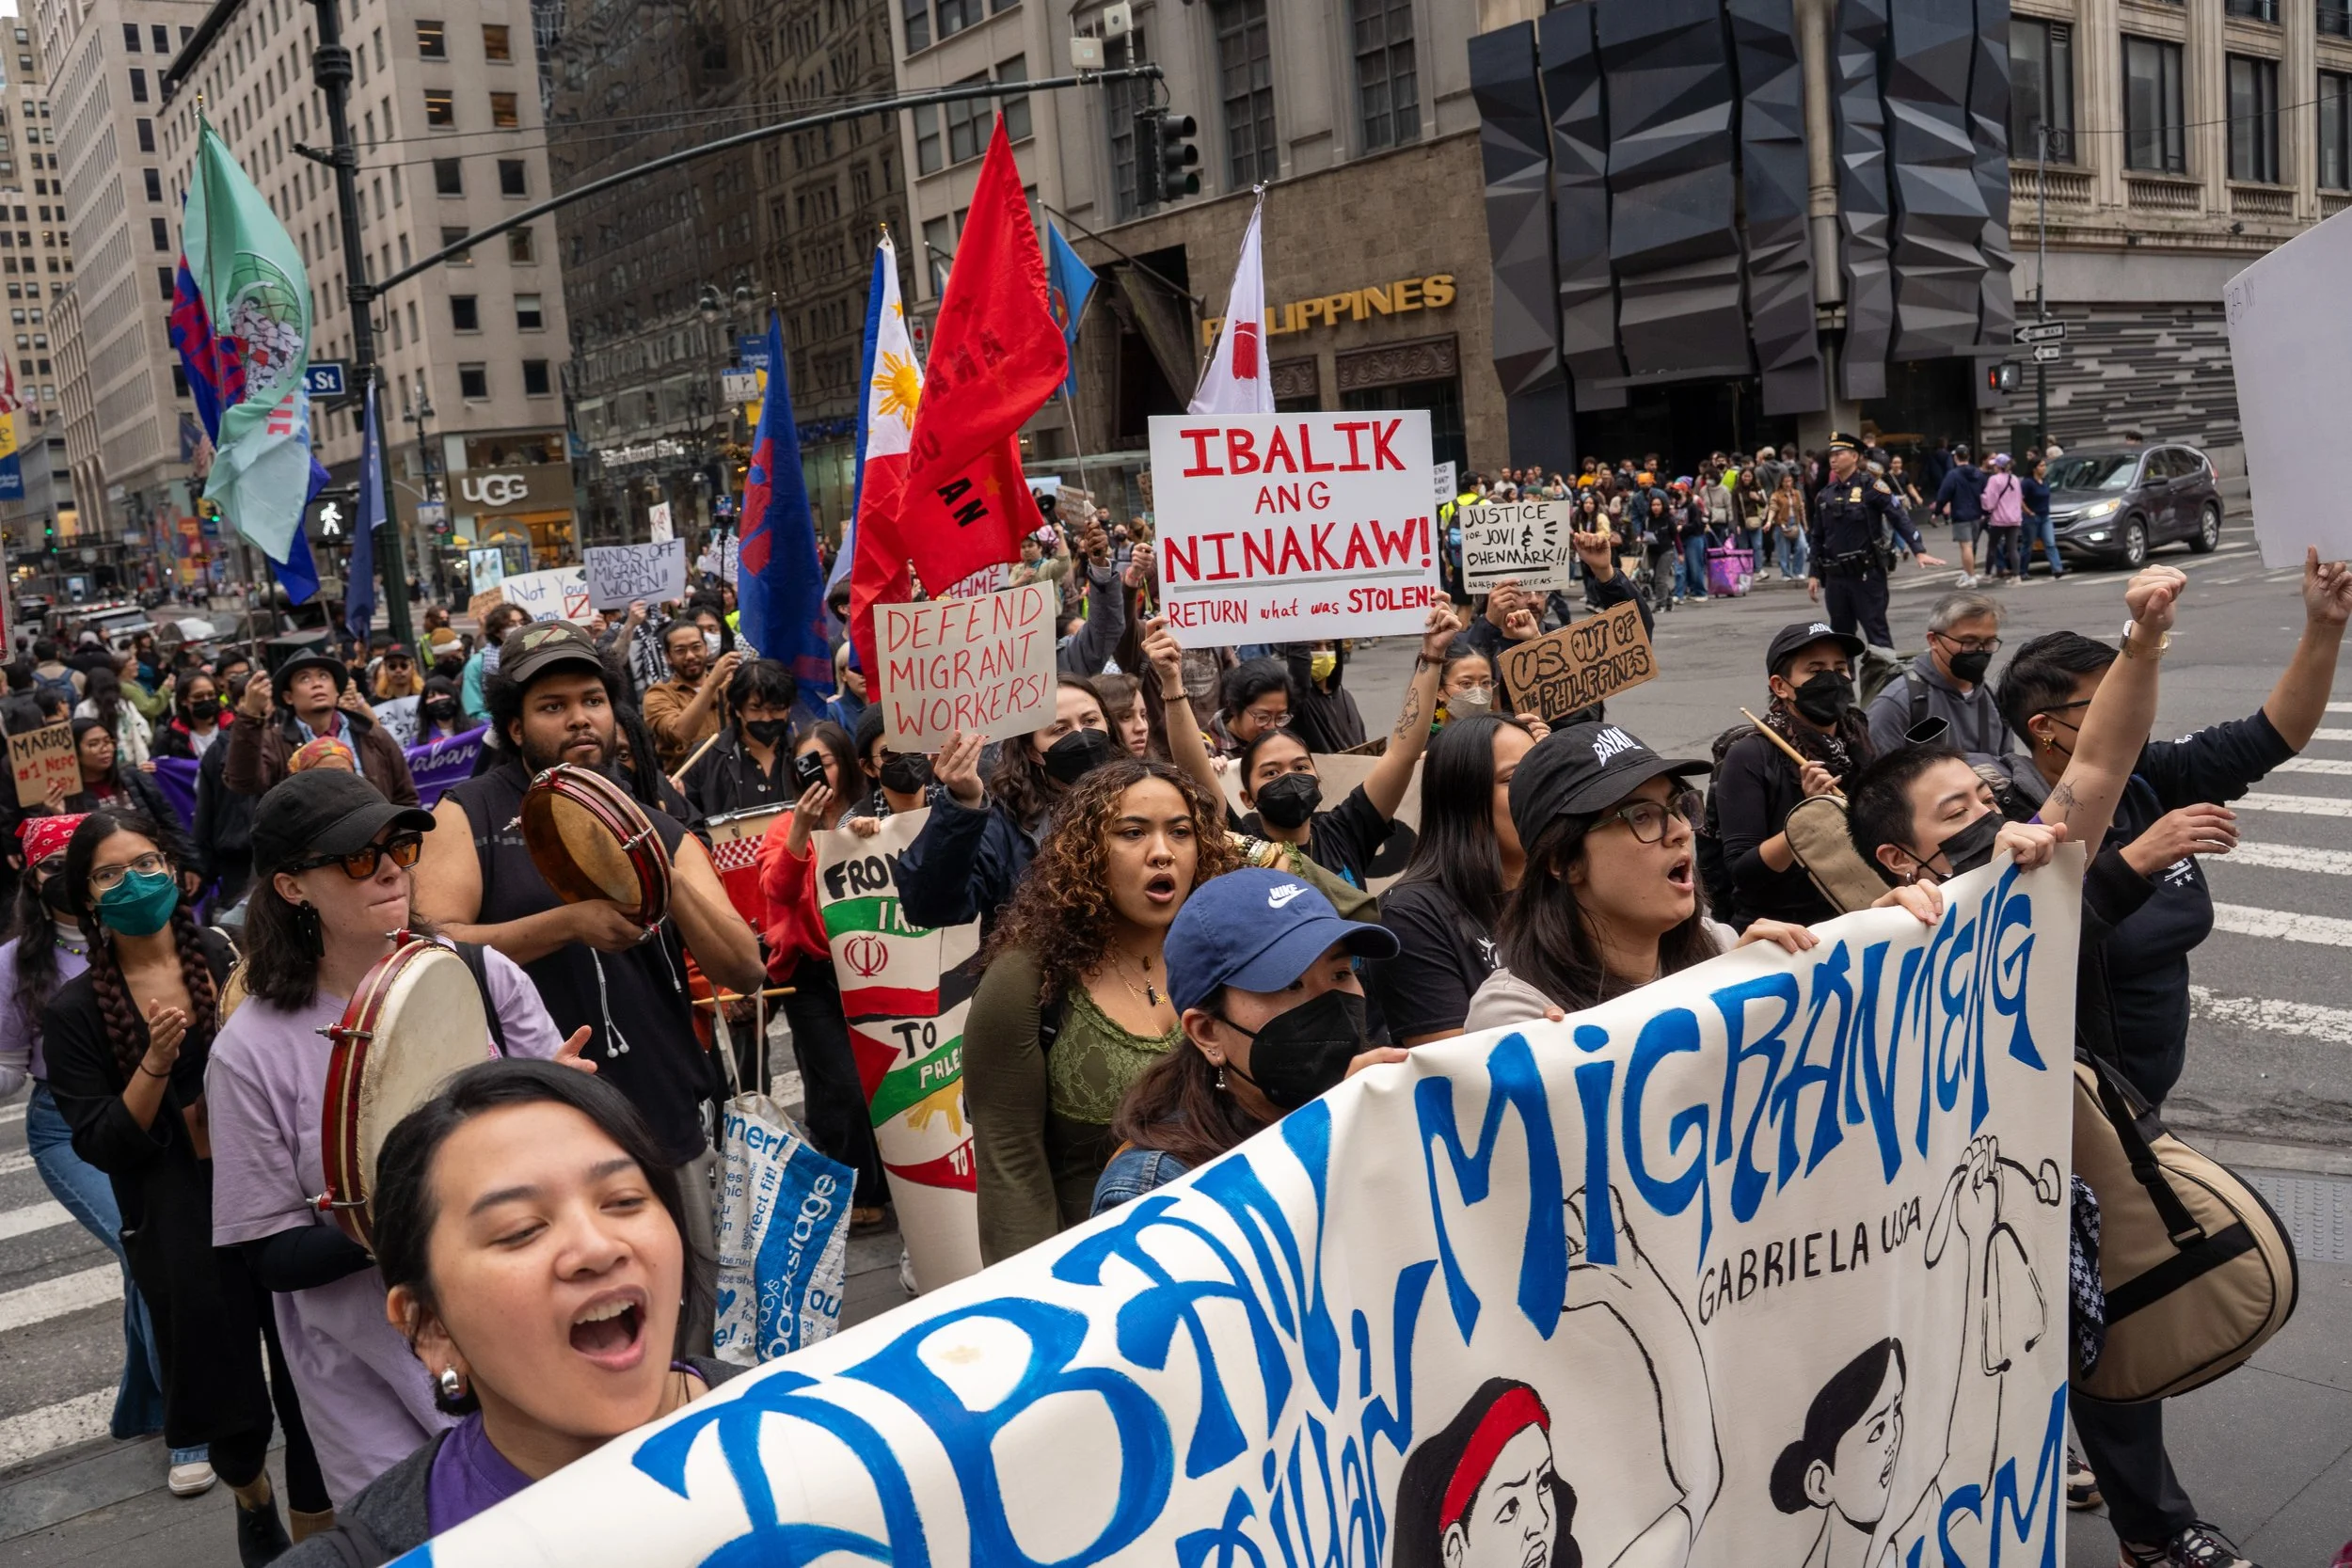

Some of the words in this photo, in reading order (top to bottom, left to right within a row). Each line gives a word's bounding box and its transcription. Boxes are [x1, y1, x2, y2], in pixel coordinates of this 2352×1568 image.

[1202, 274, 1456, 346] PLIPPINES
[314, 372, 335, 390] St
[1180, 419, 1406, 477] IBALIK
[461, 474, 528, 506] UGG
[1255, 482, 1330, 514] ANG
[1465, 504, 1549, 528] JUSTICE
[590, 546, 642, 566] HANDS
[649, 541, 676, 559] OFF
[1165, 516, 1431, 582] NINAKAW!
[1466, 531, 1482, 540] FOR
[1483, 528, 1515, 546] JOVI
[595, 558, 660, 581] MIGRANT
[509, 578, 546, 603] Not
[554, 575, 588, 596] Your
[1168, 600, 1248, 628] RETURN
[1261, 598, 1298, 619] what
[1311, 601, 1339, 615] was
[1347, 586, 1436, 613] STOLEN!
[887, 588, 1042, 652] DEFEND
[1571, 620, 1609, 662] OUT
[1613, 610, 1636, 645] OF
[890, 631, 1038, 693] MIGRANT
[1517, 691, 1539, 713] THE
[1539, 644, 1649, 721] PHILIPPINES
[896, 673, 1047, 736] WORKERS!
[12, 726, 72, 761] MARCOS
[18, 760, 41, 782] #1
[1270, 884, 1298, 900] NIKE
[892, 1021, 937, 1059] TO
[919, 1046, 963, 1089] PALE
[948, 1147, 969, 1176] TO
[1699, 1221, 1869, 1325] GABRIELA
[1881, 1196, 1921, 1254] USA
